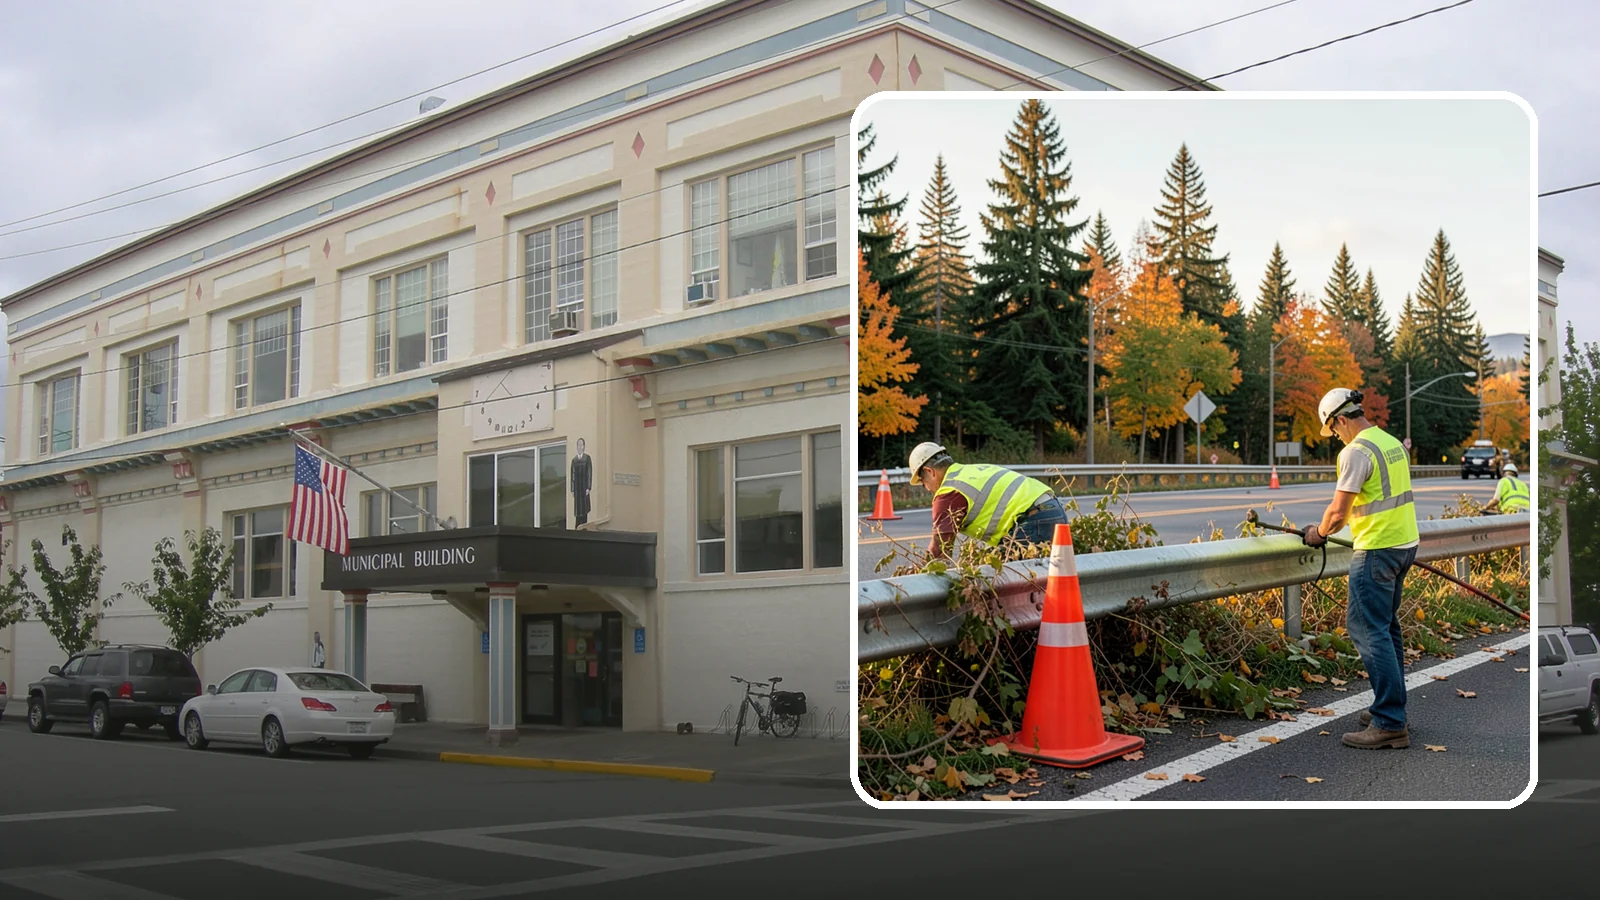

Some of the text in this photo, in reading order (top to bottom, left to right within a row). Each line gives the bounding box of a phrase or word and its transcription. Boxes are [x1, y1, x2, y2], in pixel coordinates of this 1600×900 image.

[480, 406, 485, 415] 8
[487, 417, 493, 426] 9
[528, 413, 533, 422] 3
[494, 423, 500, 432] 10
[501, 425, 506, 433] 11
[507, 425, 513, 433] 12
[521, 420, 525, 429] 2
[342, 546, 475, 572] MUNICIPAL BUILDING
